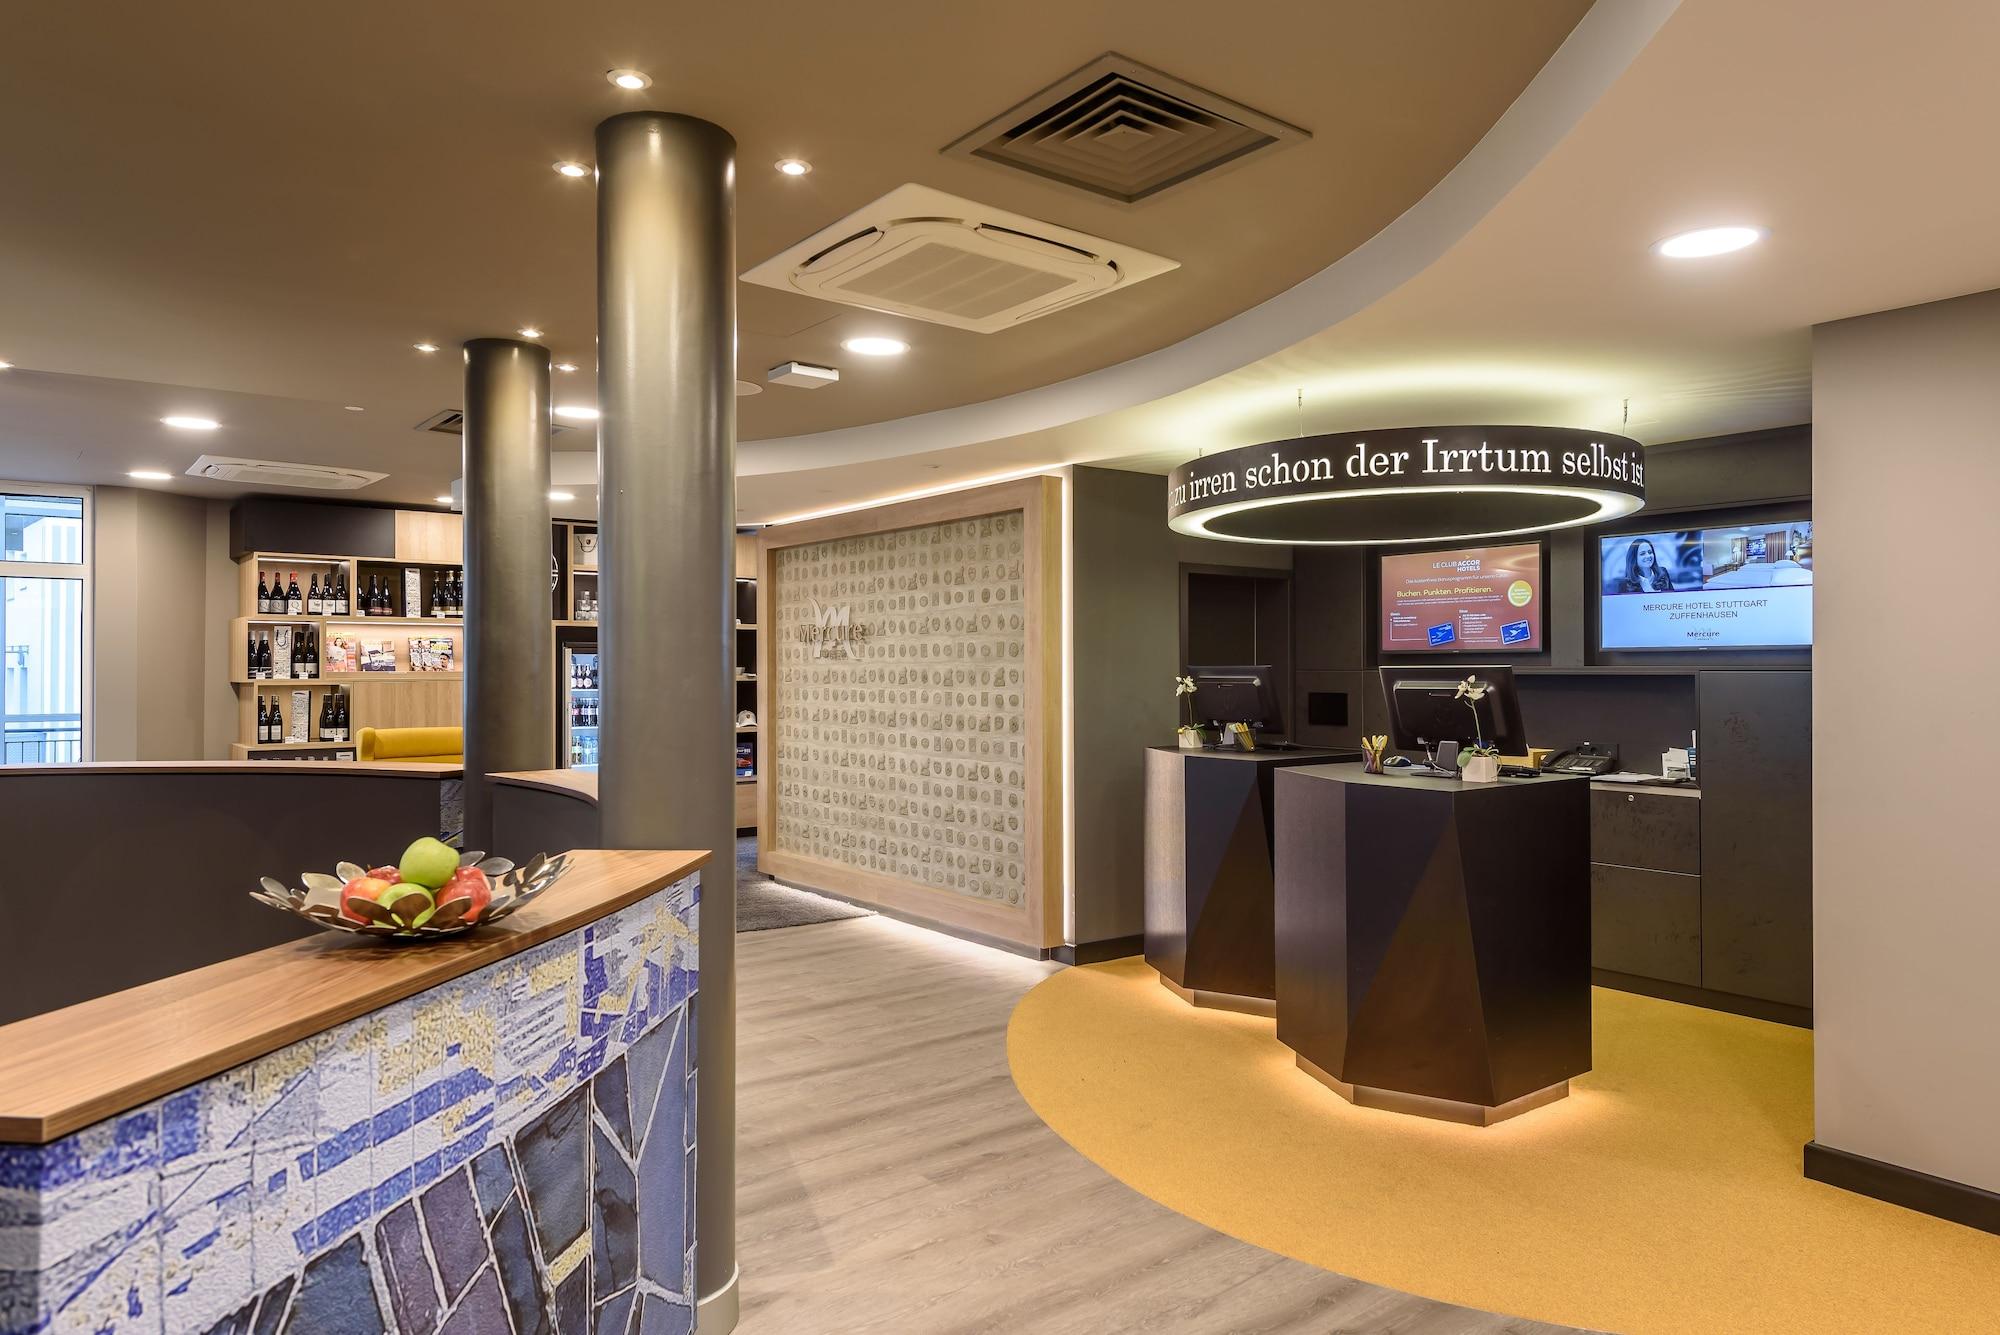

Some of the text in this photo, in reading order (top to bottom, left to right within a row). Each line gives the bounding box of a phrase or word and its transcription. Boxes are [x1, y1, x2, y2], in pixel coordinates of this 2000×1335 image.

[1174, 484, 1187, 507] zu
[1189, 471, 1237, 501] irren
[1245, 452, 1334, 488] schon
[1345, 443, 1410, 477] der
[1422, 438, 1552, 474] Irrtum
[1562, 443, 1629, 482] selbst
[1631, 451, 1645, 488] ist
[1457, 559, 1481, 567] ACCOR
[1396, 586, 1493, 598] Buchen. Punkten. Profitieren.
[1642, 599, 1768, 611] MERCURE HOTEL STUTTGART
[1669, 610, 1738, 620] ZUFFENHAUSEN
[799, 623, 864, 643] Mercure
[1687, 630, 1720, 638] Mercure
